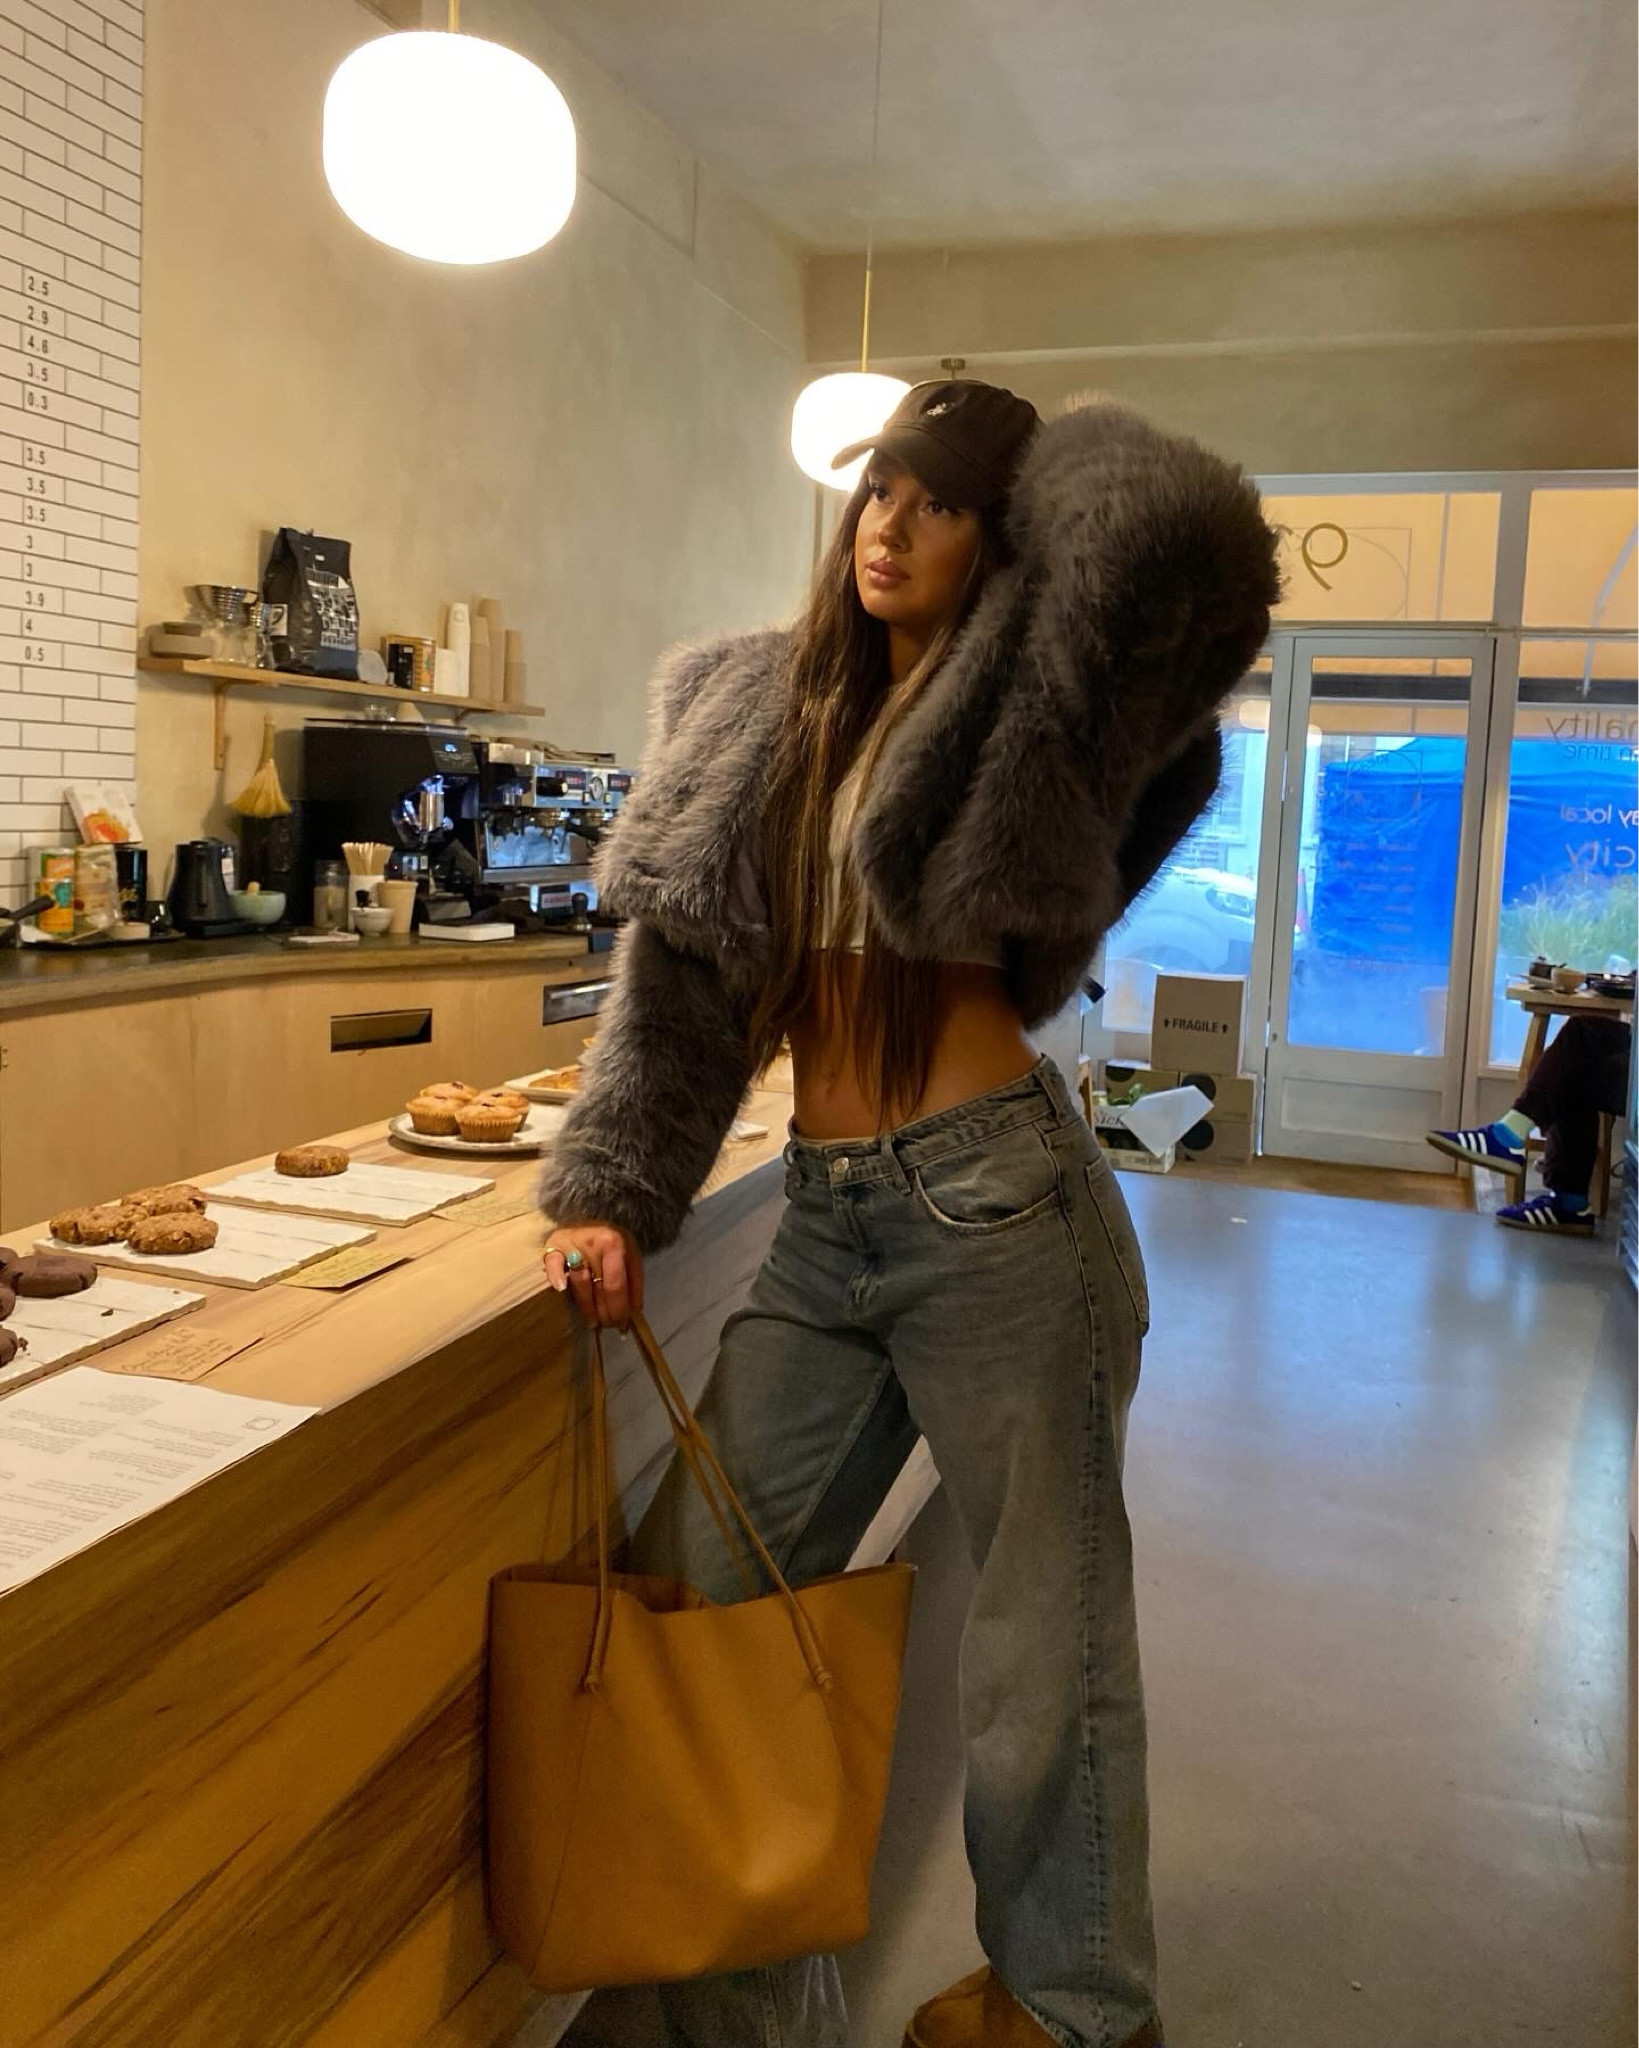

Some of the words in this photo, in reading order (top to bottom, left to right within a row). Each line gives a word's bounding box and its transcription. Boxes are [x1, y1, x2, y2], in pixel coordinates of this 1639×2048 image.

[27, 275, 49, 297] 2.5
[27, 305, 49, 325] 2.9
[27, 362, 48, 382] 3.5
[27, 391, 48, 410] 0.3
[26, 447, 46, 465] 3.5
[26, 477, 46, 495] 3.5
[26, 505, 46, 522] 3.5
[26, 535, 33, 549] 3
[26, 563, 33, 577] 3
[25, 590, 45, 607] 3.9
[25, 618, 33, 632] 4
[24, 646, 45, 662] 0.5
[1172, 1018, 1218, 1033] FRAGILE
